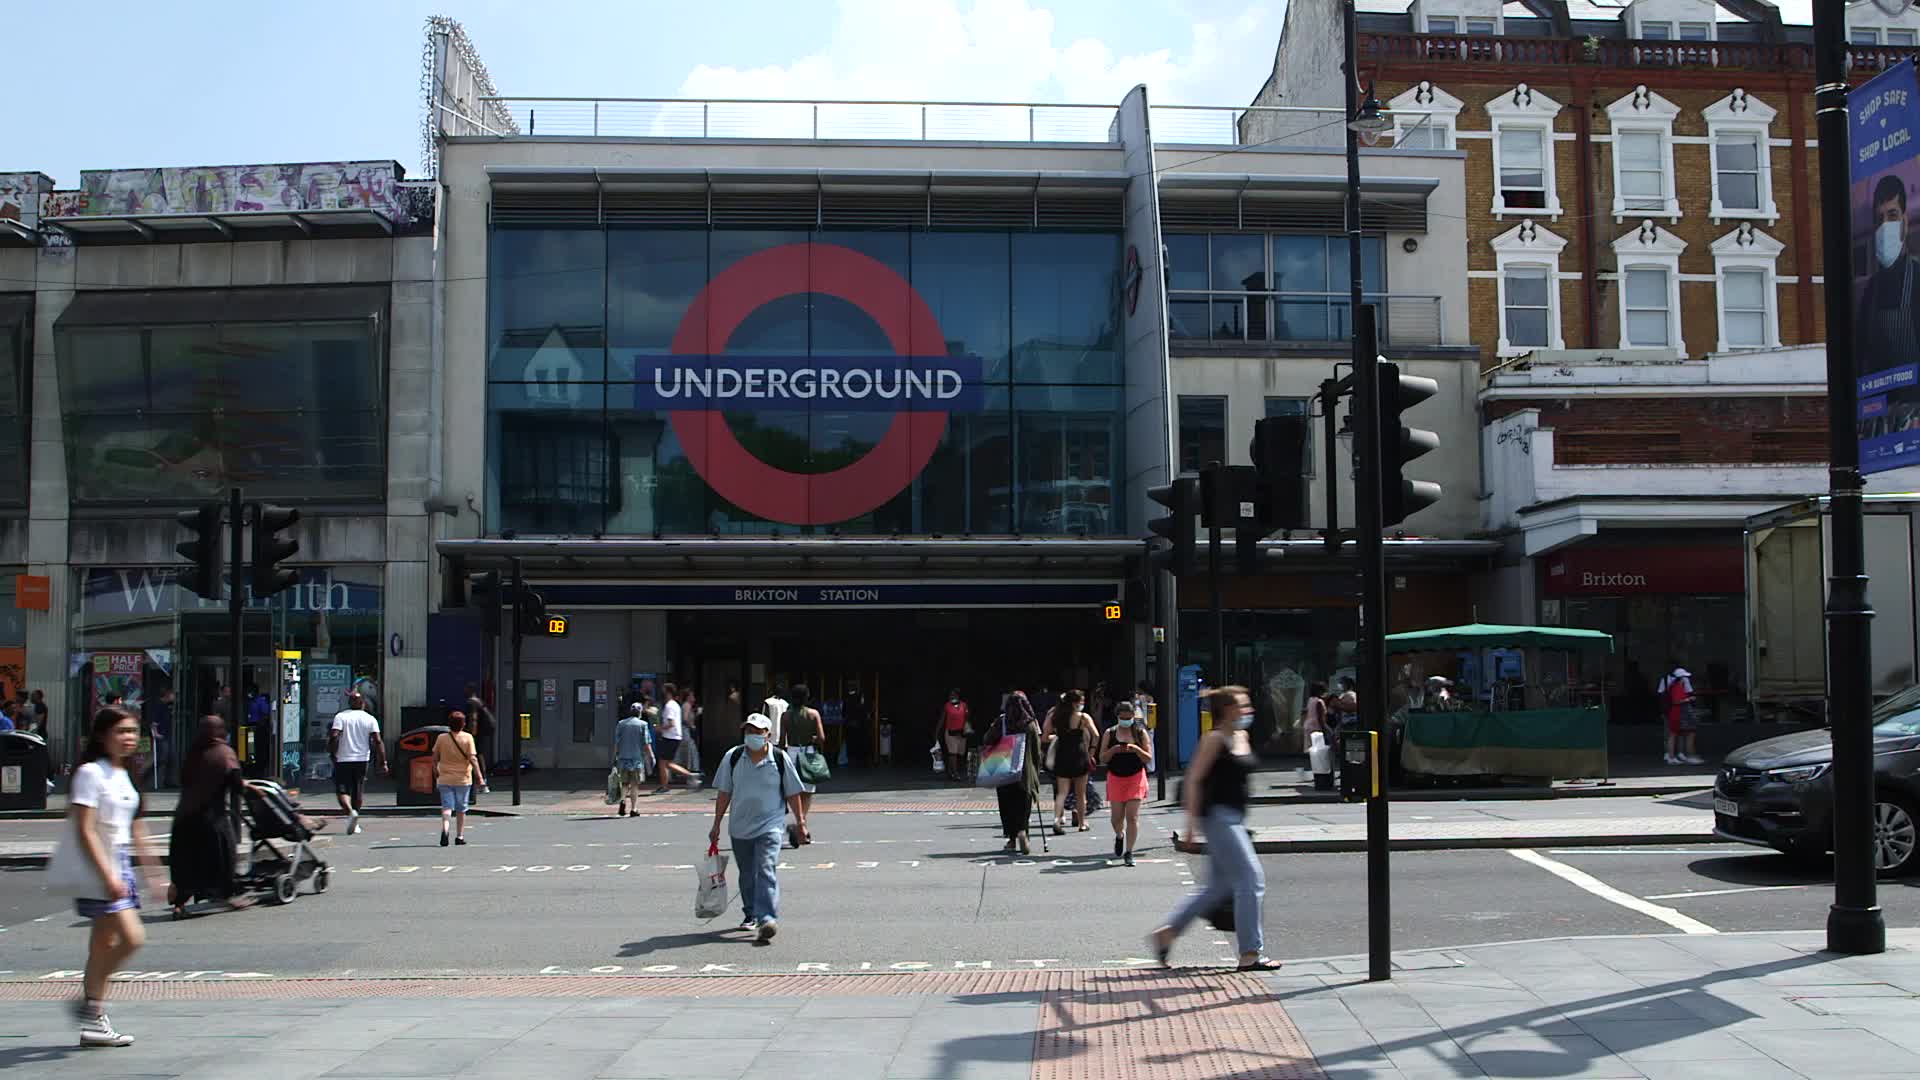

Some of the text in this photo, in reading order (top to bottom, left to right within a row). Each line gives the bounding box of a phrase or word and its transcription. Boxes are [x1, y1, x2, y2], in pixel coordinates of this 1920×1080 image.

[1859, 90, 1907, 125] SHOP SAFE
[1859, 128, 1911, 162] SHOP LOCAL
[655, 368, 962, 398] UNDERGROUND
[1583, 572, 1646, 586] Brixton
[735, 590, 879, 601] BRIXTON STATION
[1105, 606, 1121, 619] 08
[549, 620, 565, 633] 08
[111, 655, 142, 664] HALF
[113, 664, 139, 672] PRICE
[313, 669, 346, 680] TECH
[489, 865, 631, 873] LOOK
[539, 959, 1059, 973] LOOK RIGHT
